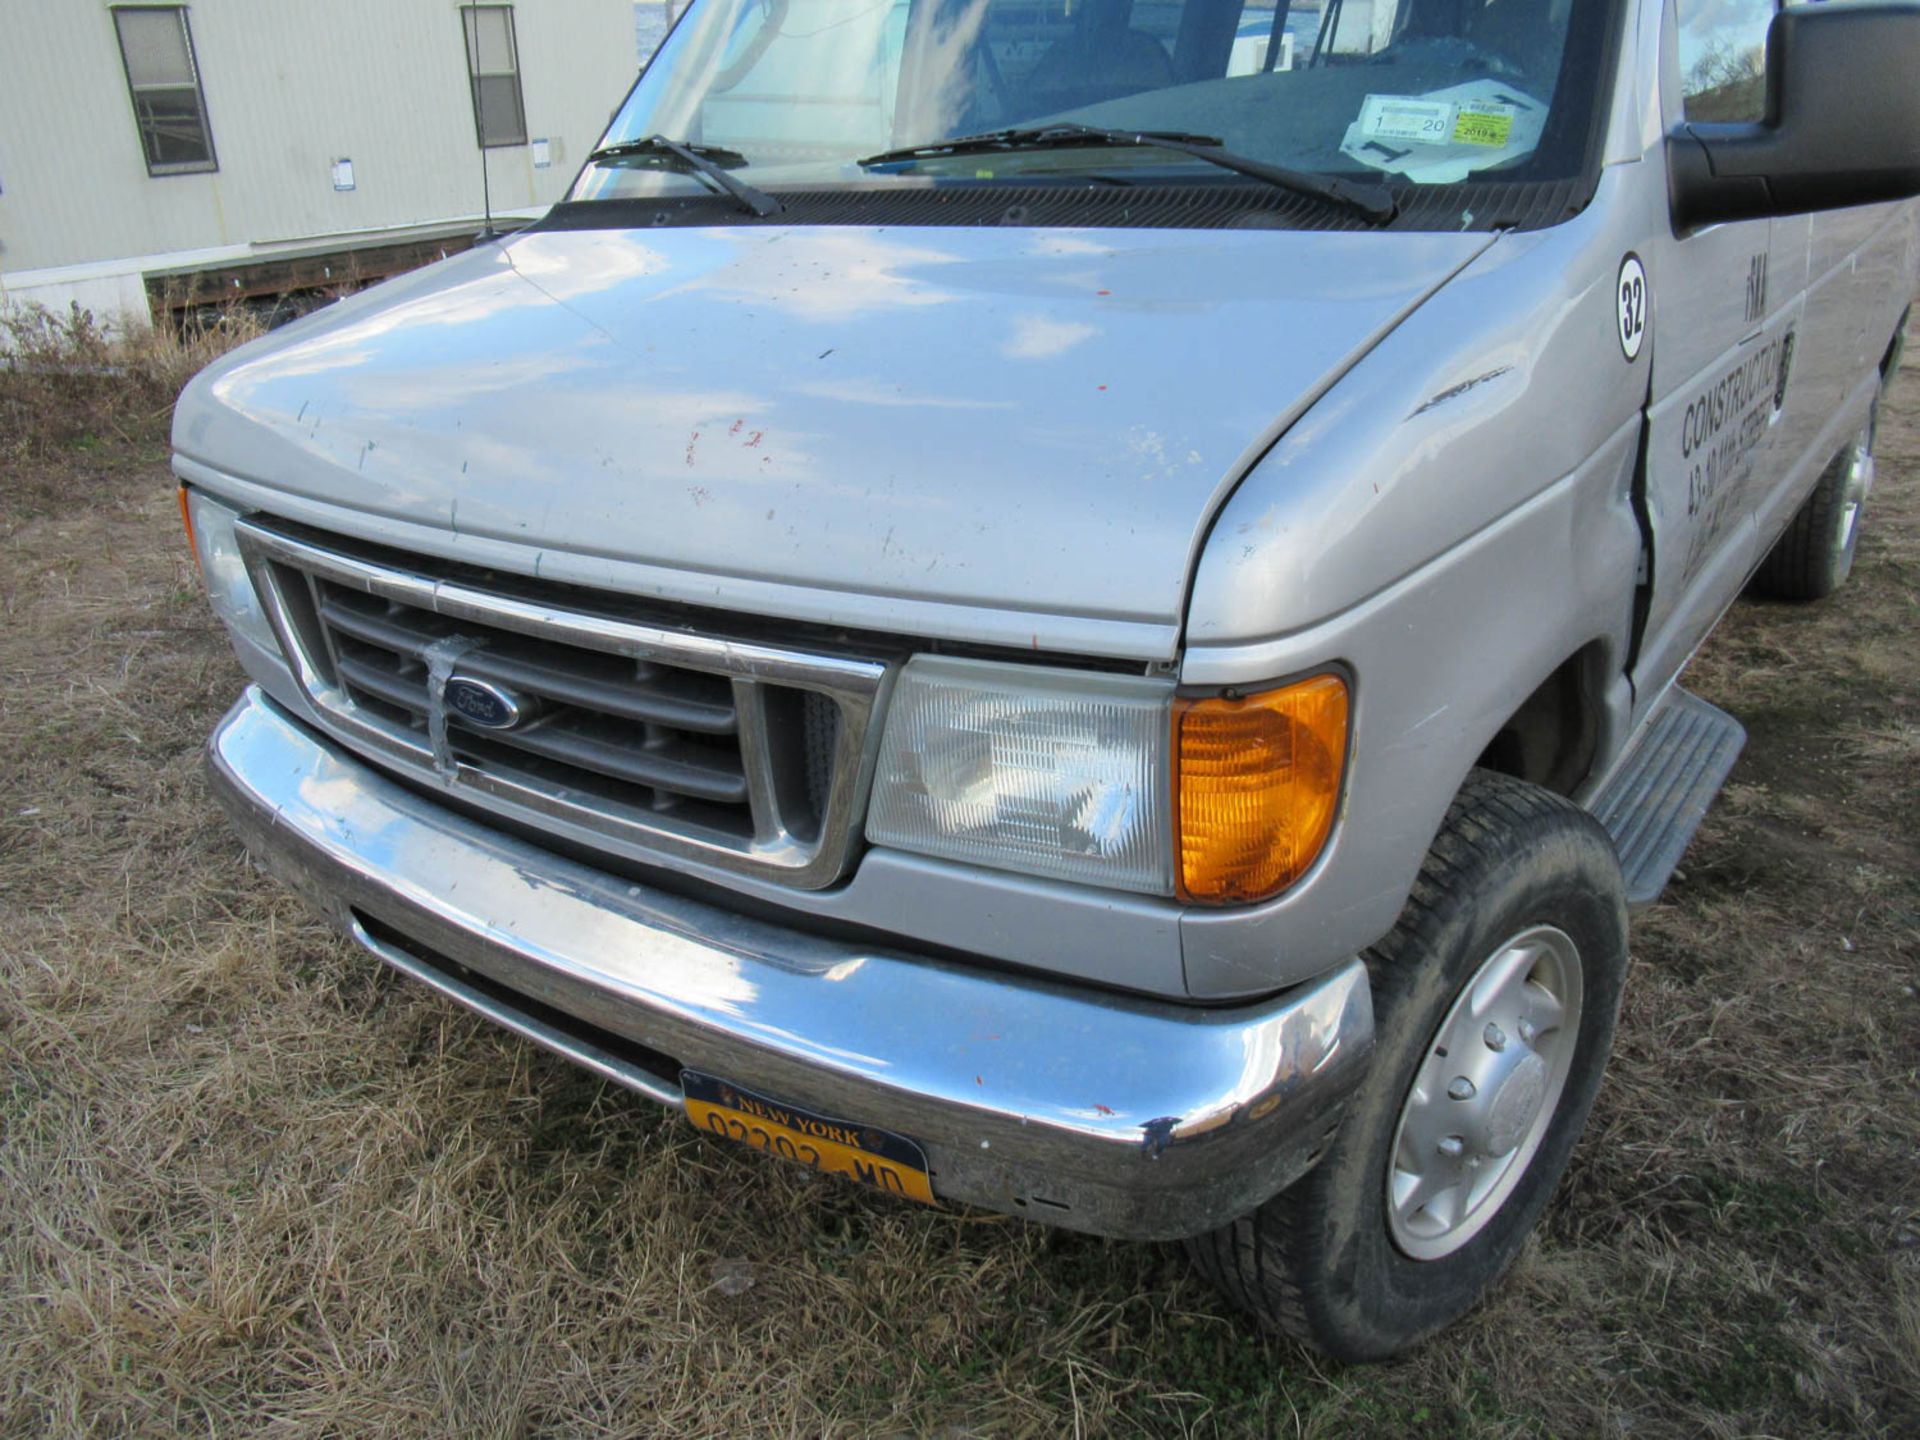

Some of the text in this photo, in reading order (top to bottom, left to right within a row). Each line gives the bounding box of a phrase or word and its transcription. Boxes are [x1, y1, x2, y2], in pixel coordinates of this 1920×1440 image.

[1423, 119, 1445, 132] 20
[1622, 276, 1643, 340] 32
[456, 686, 496, 718] Ford
[738, 1096, 861, 1147] NEW YORK
